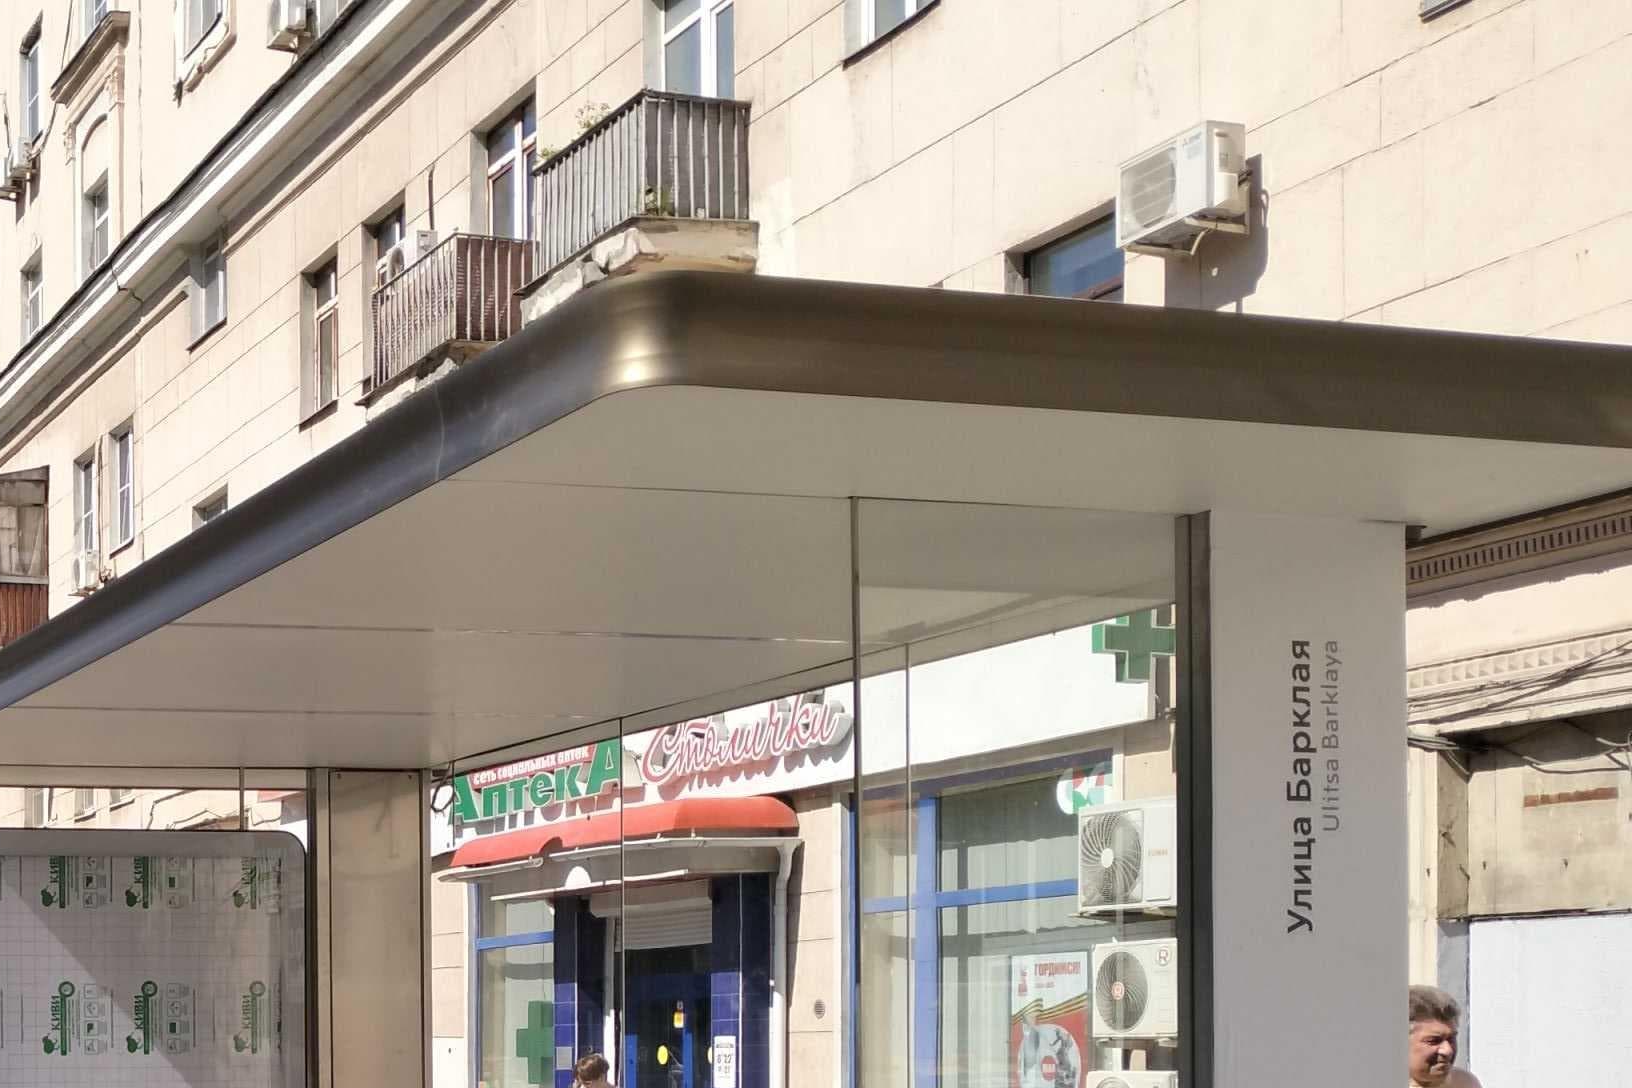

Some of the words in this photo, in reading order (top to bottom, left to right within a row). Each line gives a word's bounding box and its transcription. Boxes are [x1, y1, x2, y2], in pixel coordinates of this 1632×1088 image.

[1286, 639, 1317, 803] Барклая
[1320, 639, 1343, 749] Barklaya
[473, 771, 497, 785] сеть
[498, 755, 557, 780] социальных
[1321, 758, 1341, 831] Ulitsa
[1287, 816, 1316, 934] Улица
[51, 995, 61, 1031] КИВИ
[134, 995, 144, 1030] КИВИ
